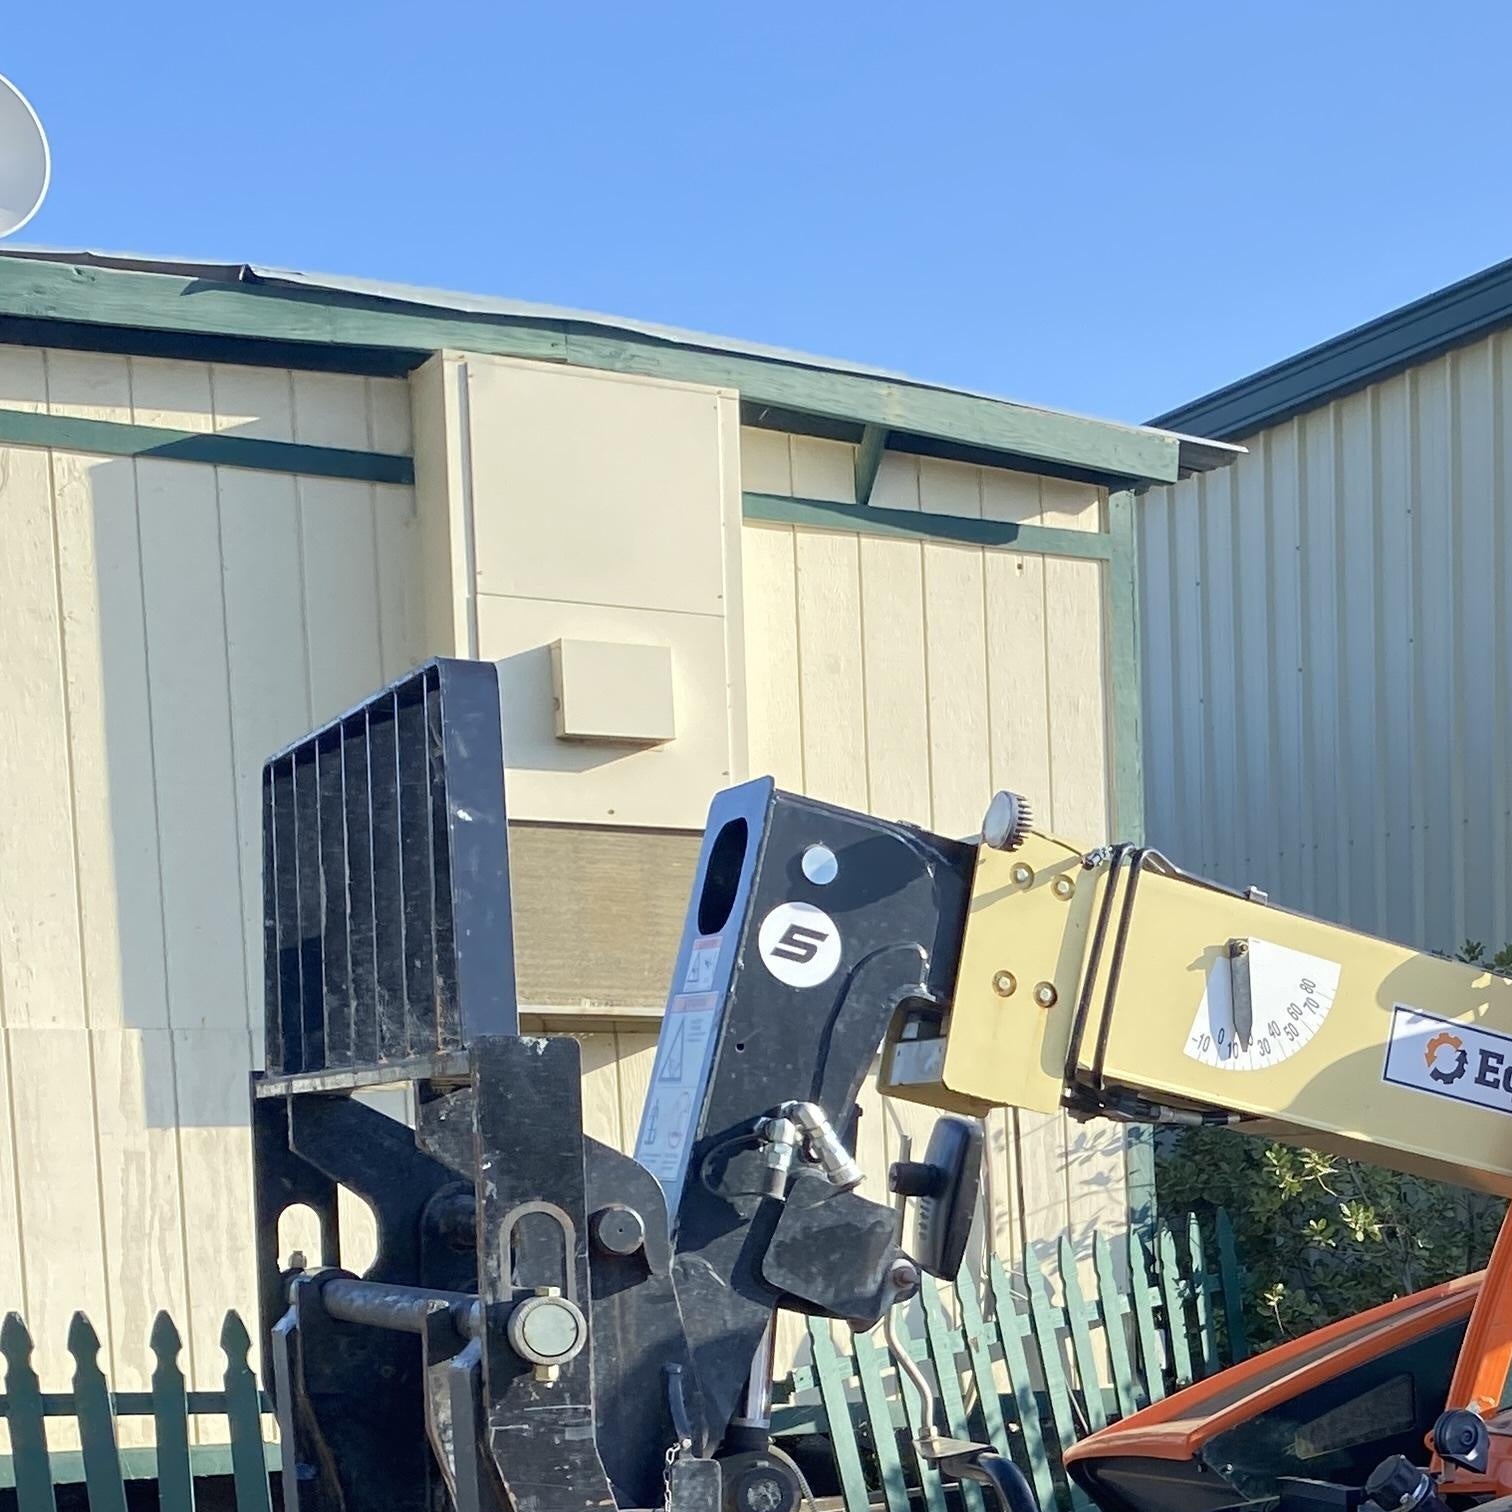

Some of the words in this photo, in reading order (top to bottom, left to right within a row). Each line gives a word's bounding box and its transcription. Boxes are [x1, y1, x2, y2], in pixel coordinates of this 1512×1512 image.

[1299, 977, 1317, 995] 80
[1286, 1002, 1304, 1022] 60
[1302, 996, 1320, 1015] 70
[1217, 1027, 1225, 1045] 0
[1267, 1020, 1282, 1039] 40
[1283, 1022, 1300, 1042] 50
[1192, 1032, 1211, 1053] -10
[1227, 1040, 1239, 1060] 10
[1257, 1037, 1272, 1057] 30
